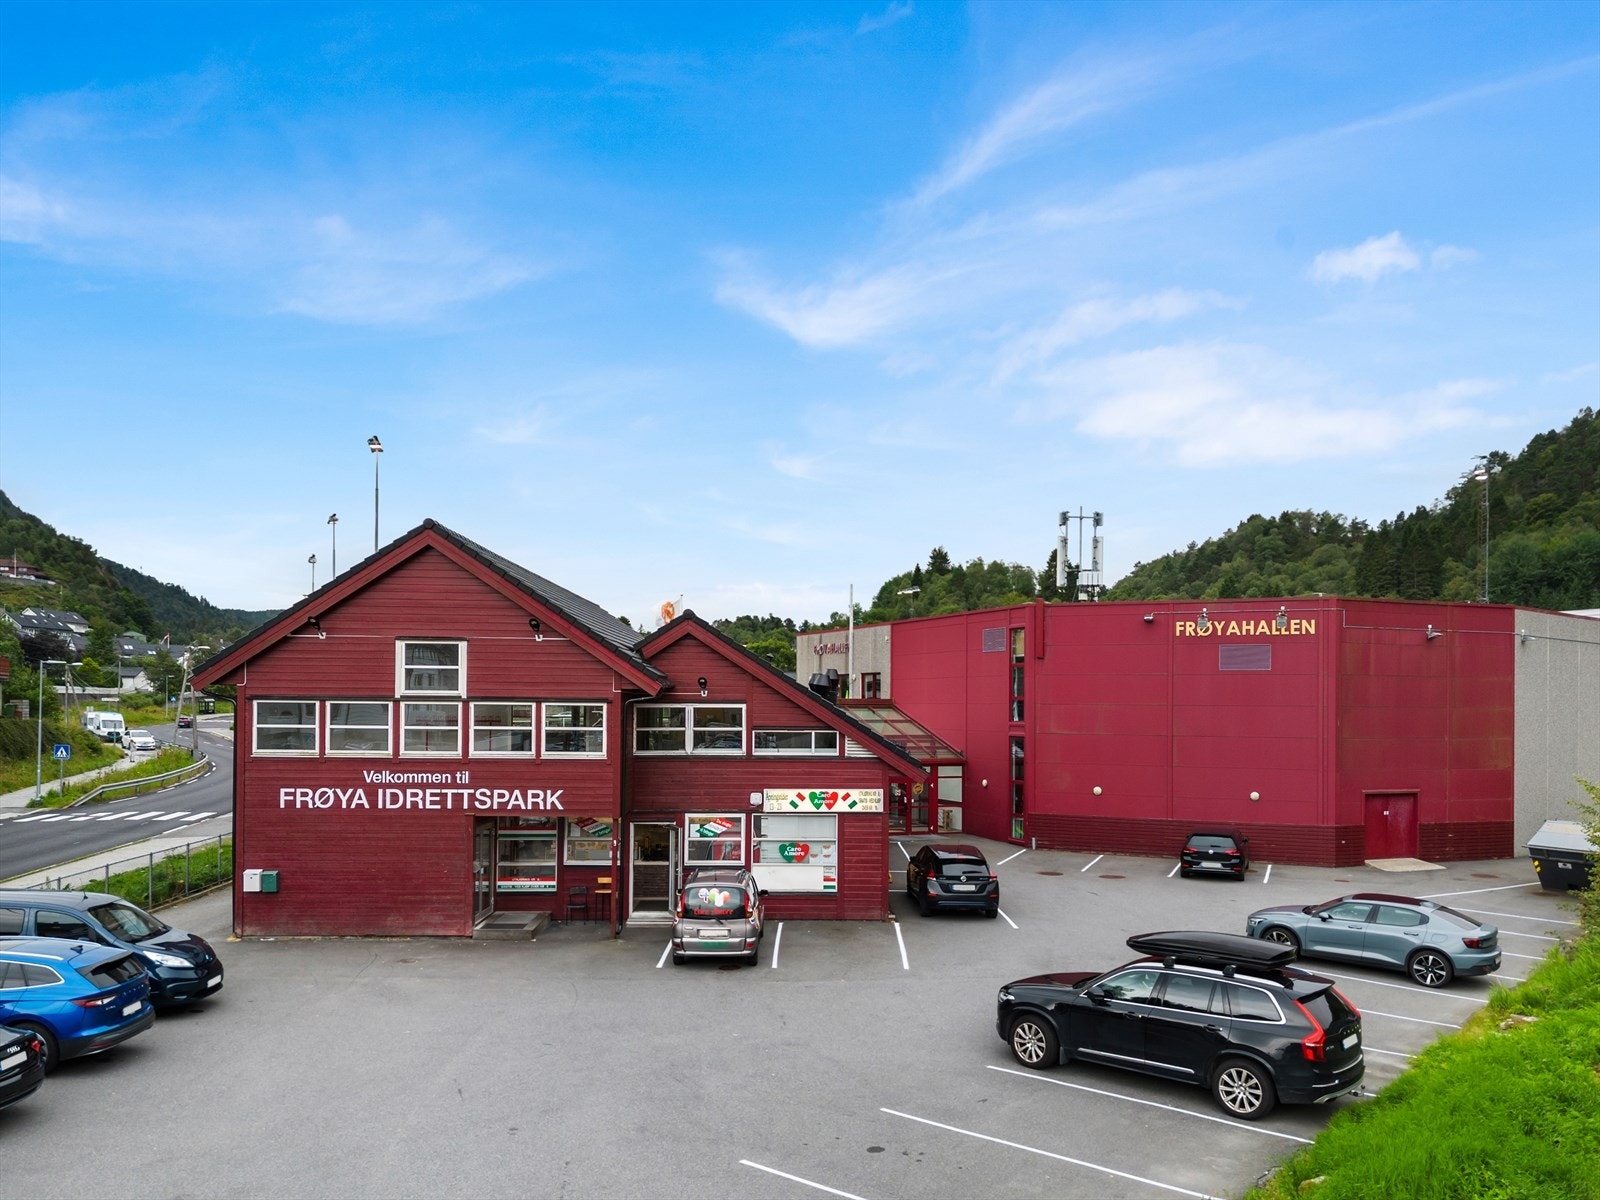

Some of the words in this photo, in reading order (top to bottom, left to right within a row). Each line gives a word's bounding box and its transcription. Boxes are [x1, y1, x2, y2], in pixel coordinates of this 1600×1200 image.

[1175, 619, 1316, 637] FRØYAHALLEN
[813, 642, 850, 655] FRØYAHALLE
[363, 770, 451, 784] Velkommen
[455, 770, 469, 784] til
[279, 787, 369, 810] FRØYA
[377, 788, 564, 811] IDRETTSPARK
